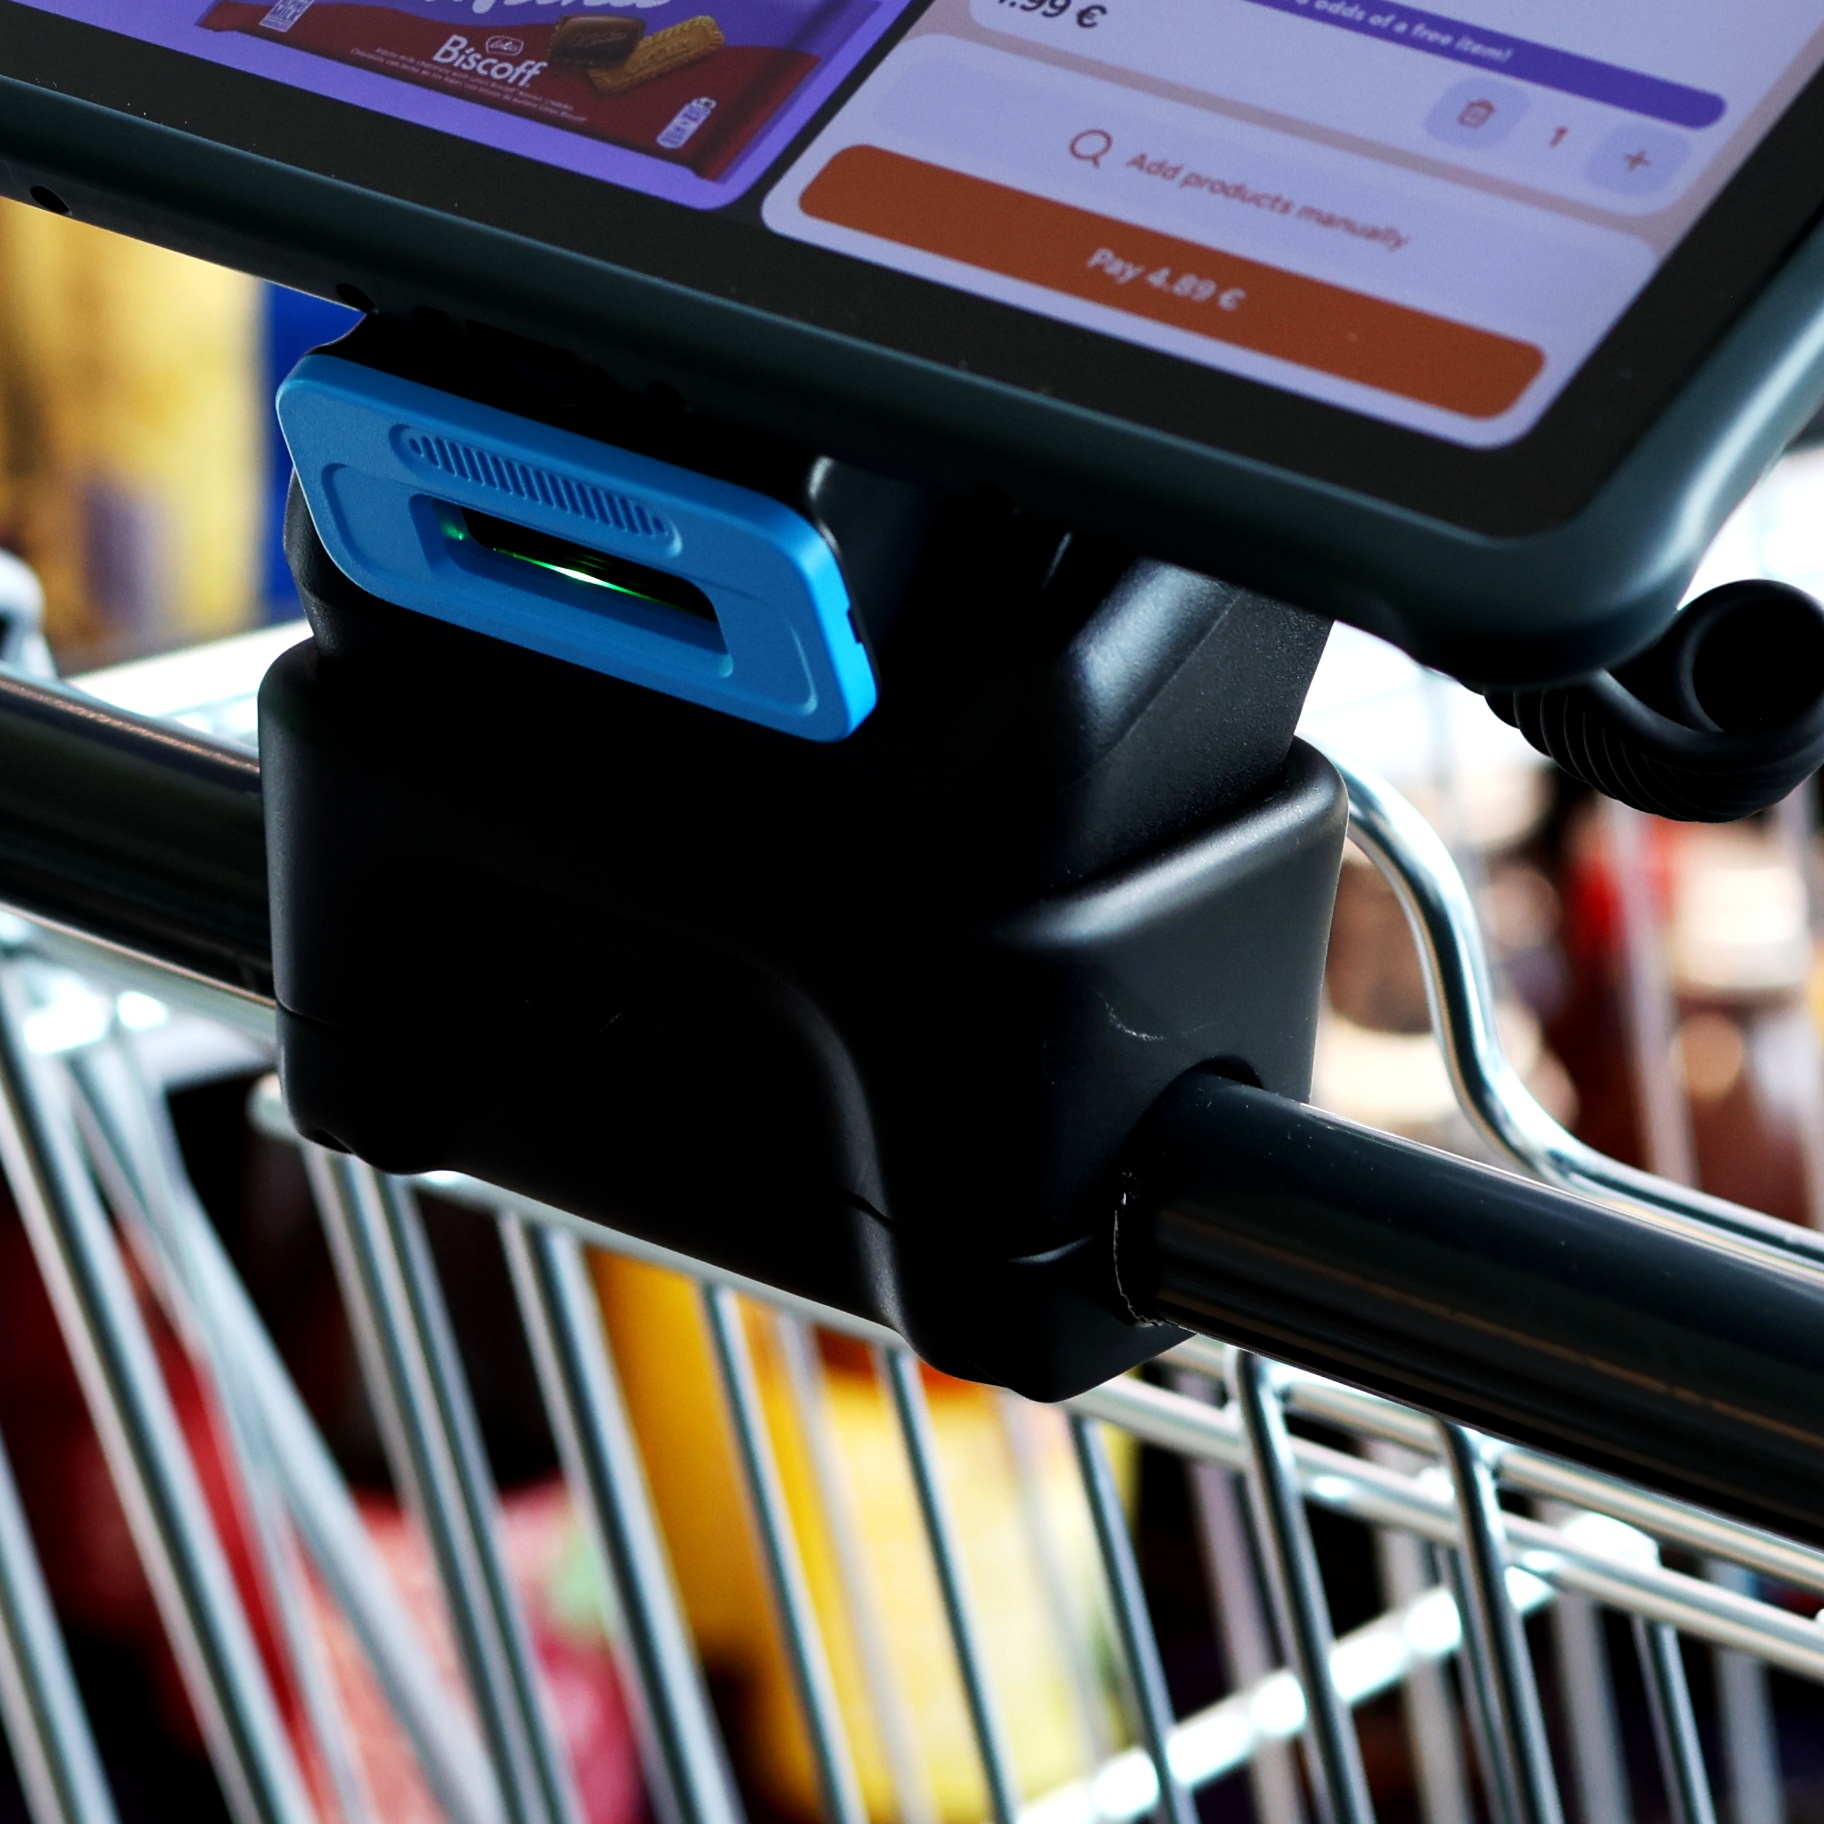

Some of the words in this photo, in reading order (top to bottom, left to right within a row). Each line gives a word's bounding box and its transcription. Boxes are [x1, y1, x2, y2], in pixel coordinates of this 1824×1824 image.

[1076, 3, 1108, 29] €
[1312, 0, 1366, 24] odds
[1367, 12, 1399, 29] of
[1393, 20, 1408, 33] a
[1407, 22, 1454, 48] free
[432, 34, 549, 88] Biscoff
[1550, 126, 1568, 148] 1
[1125, 152, 1184, 181] Add
[1180, 173, 1295, 216] products
[1295, 204, 1412, 253] manually
[1085, 247, 1145, 286] Pay
[1217, 286, 1248, 313] €
